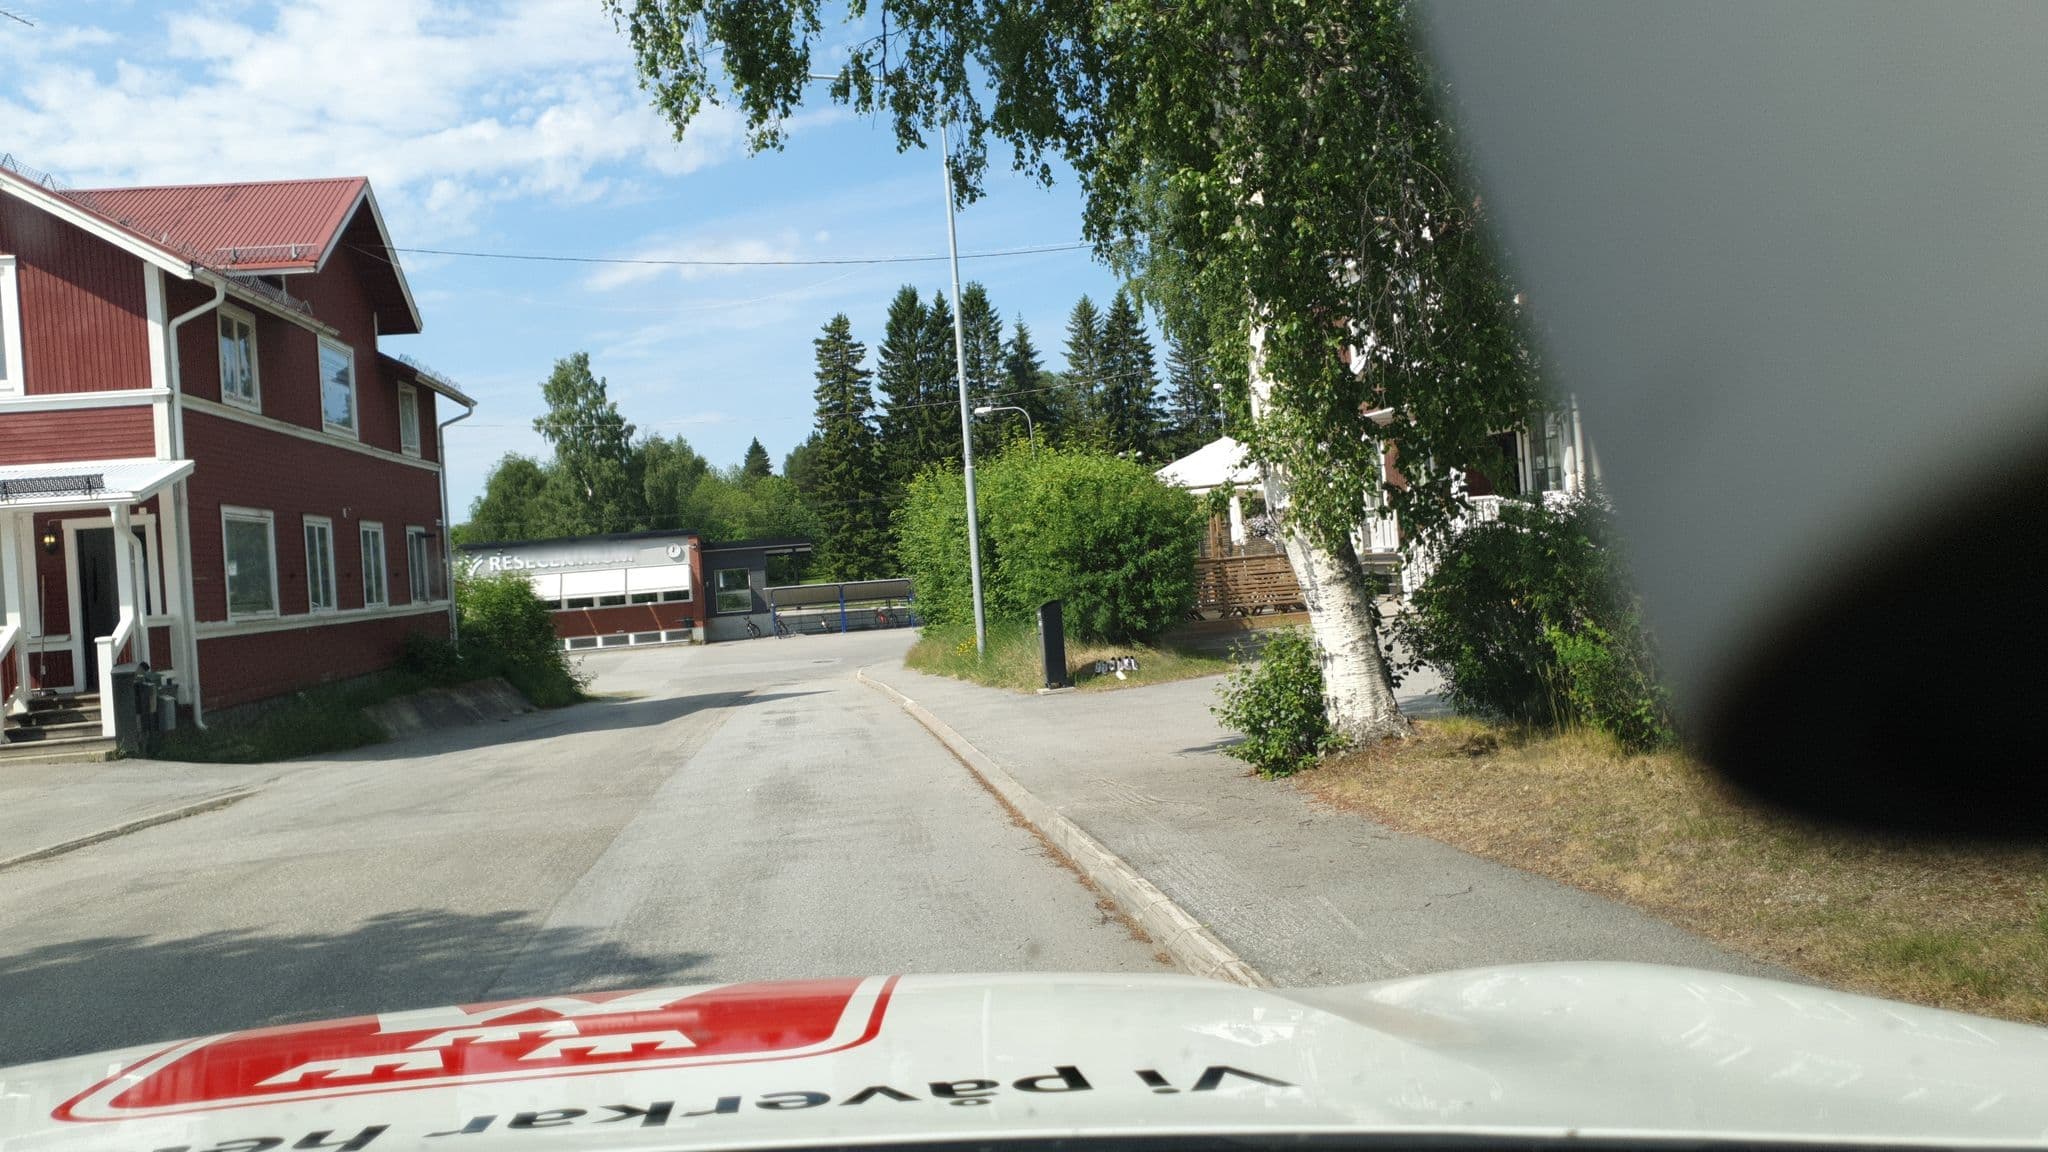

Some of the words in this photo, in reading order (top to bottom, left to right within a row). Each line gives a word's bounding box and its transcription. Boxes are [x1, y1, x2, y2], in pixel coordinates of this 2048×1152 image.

[1134, 1065, 1299, 1093] Vi
[421, 1065, 1094, 1138] påverkar
[152, 1124, 392, 1152] he
